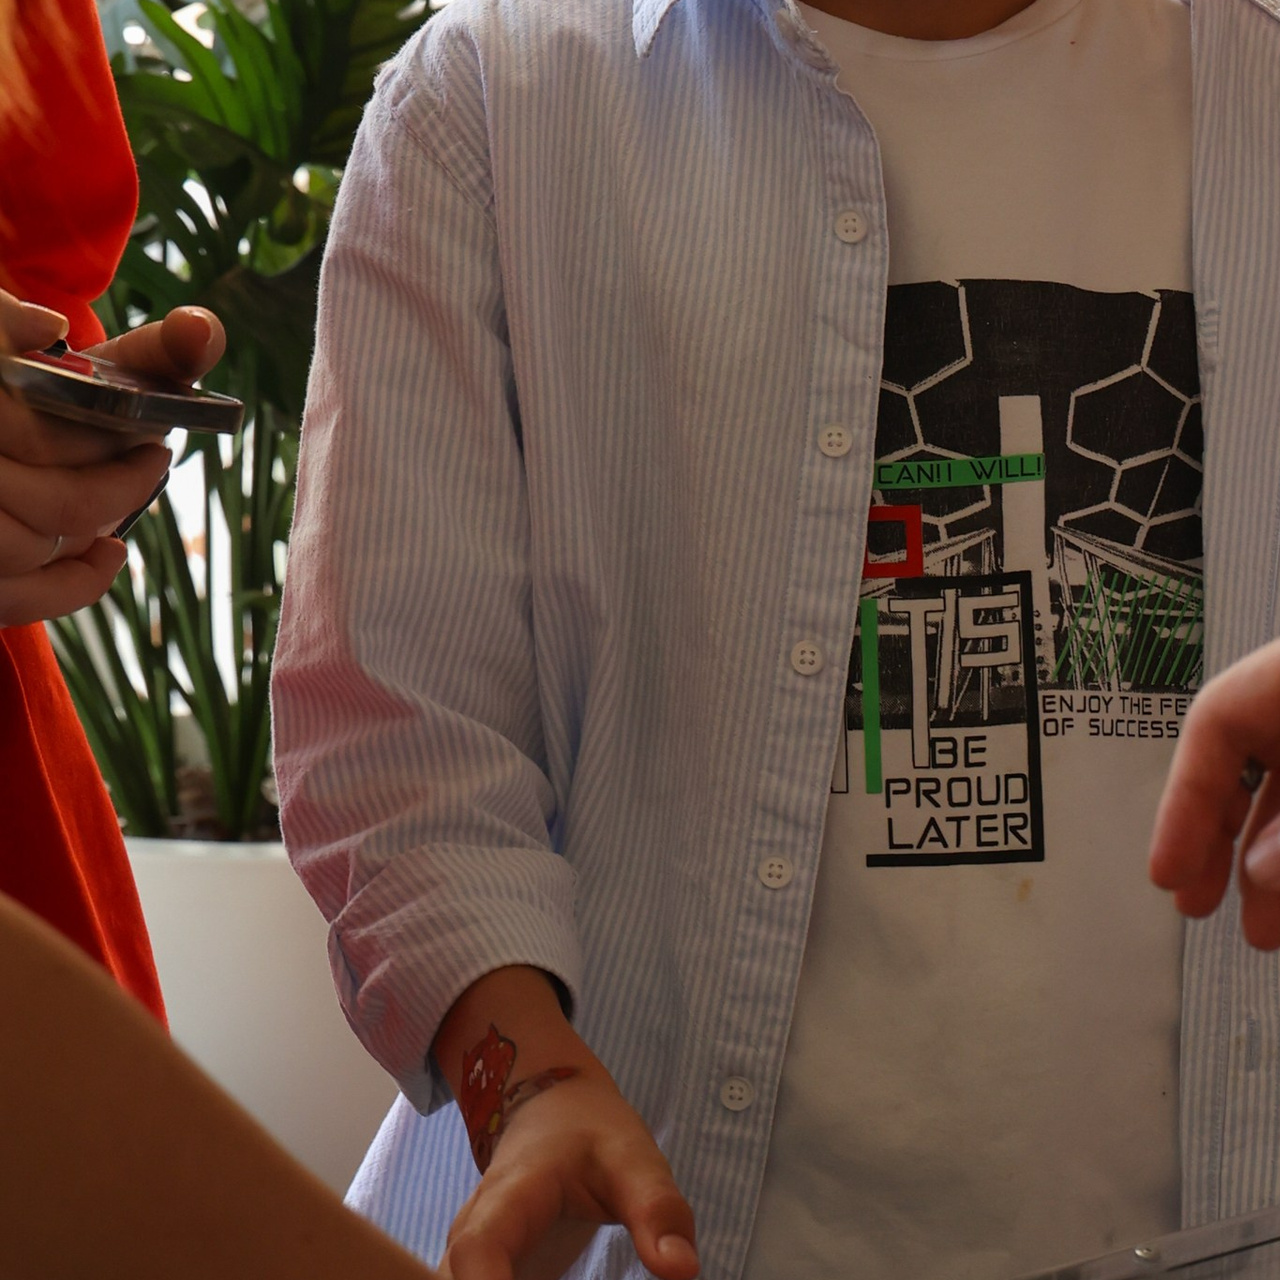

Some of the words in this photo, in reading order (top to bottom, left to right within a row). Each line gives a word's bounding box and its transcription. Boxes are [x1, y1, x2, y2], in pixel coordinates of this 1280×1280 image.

[969, 457, 1042, 480] WILL!
[1042, 694, 1113, 713] ENJOY
[1119, 696, 1152, 715] THE
[1160, 698, 1193, 716] FE
[1043, 717, 1075, 737] OF
[1089, 718, 1179, 738] SUCCESS
[930, 735, 987, 768] BE
[885, 772, 1028, 809] PROUD
[887, 811, 1029, 850] LATER
